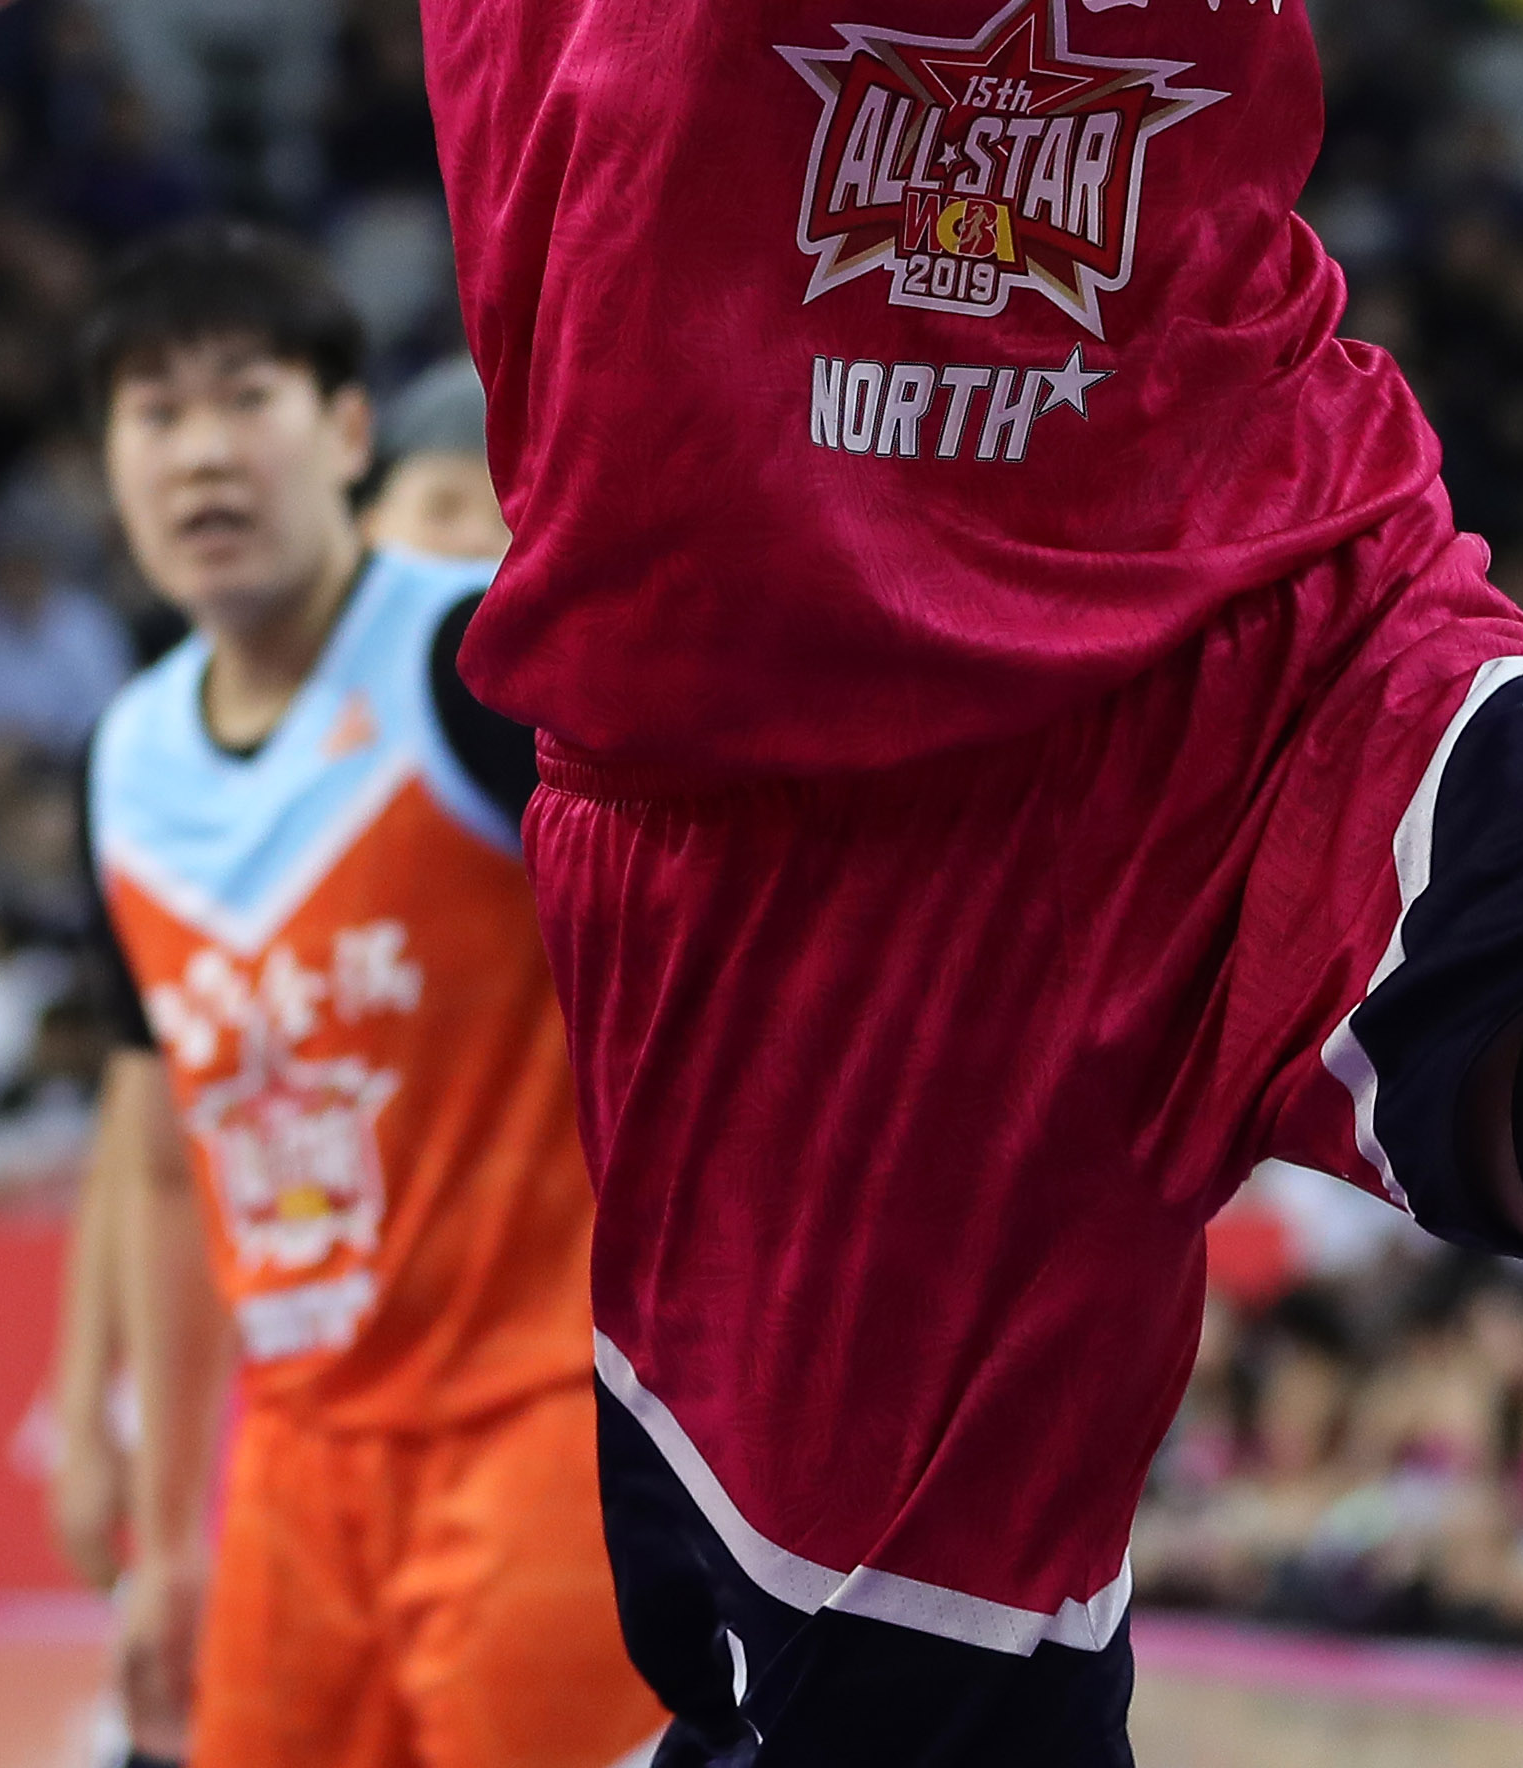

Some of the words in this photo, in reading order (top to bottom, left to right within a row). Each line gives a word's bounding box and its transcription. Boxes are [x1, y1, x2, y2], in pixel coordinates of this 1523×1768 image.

[961, 75, 1033, 112] 15th
[904, 253, 996, 302] 2019
[810, 355, 1047, 462] NORTH
